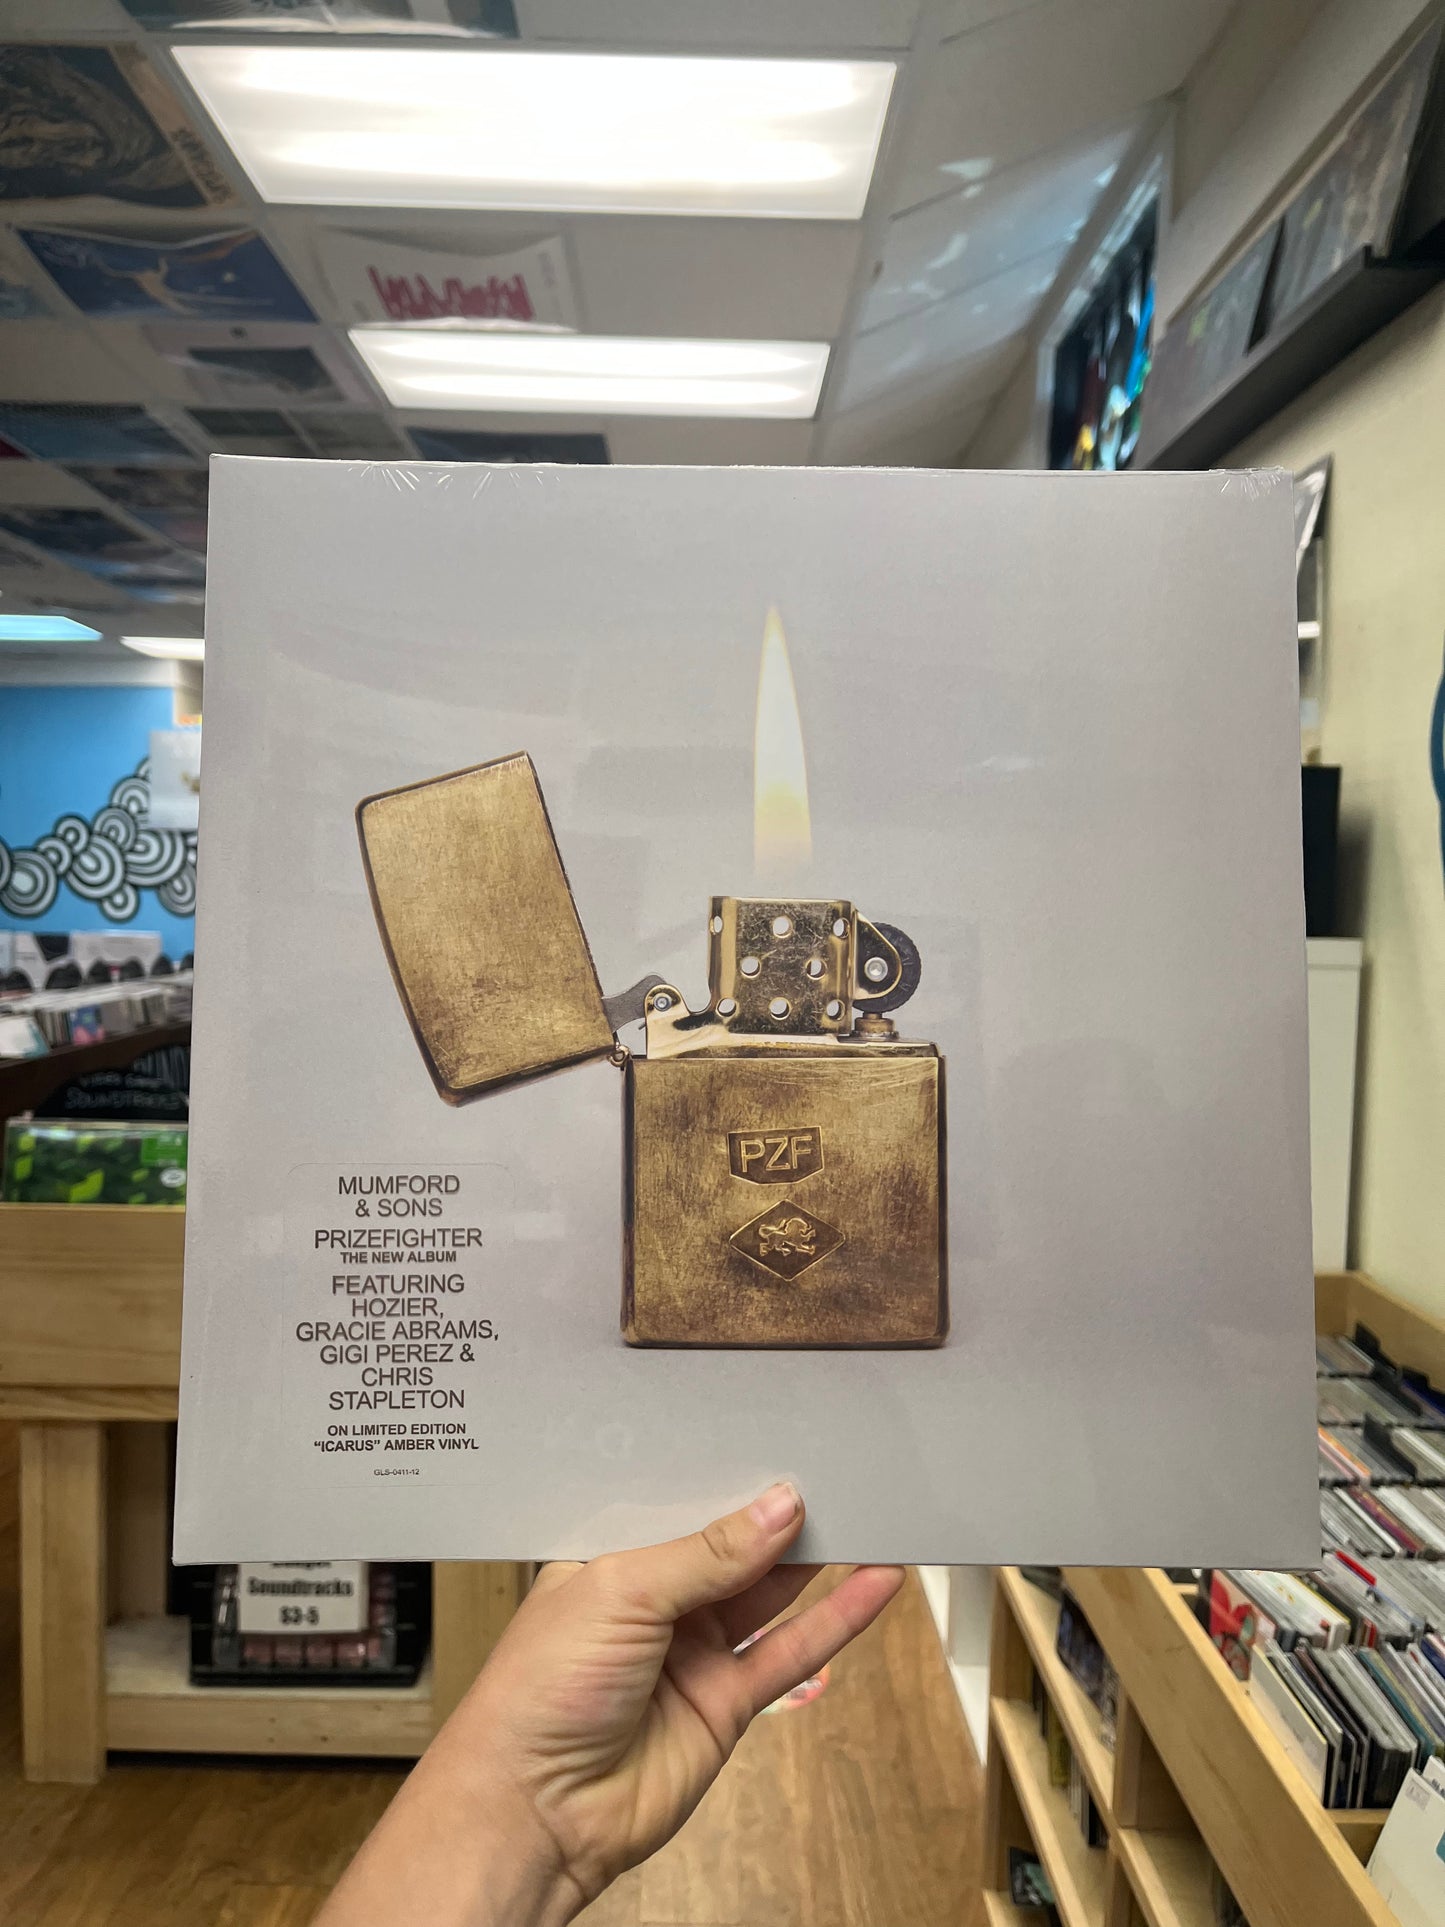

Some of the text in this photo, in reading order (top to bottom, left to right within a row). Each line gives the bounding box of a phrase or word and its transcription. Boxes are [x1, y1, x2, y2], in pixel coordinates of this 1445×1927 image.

[740, 1135, 813, 1173] PZF
[339, 1175, 459, 1194] MUMFORD
[356, 1198, 442, 1217] & SONS
[315, 1228, 482, 1249] PRIZEFIGHTER
[340, 1251, 456, 1264] THE NEW ALBUM
[333, 1274, 464, 1295] FEATURING
[352, 1298, 443, 1319] HOZIER,
[296, 1320, 498, 1342] GRACIE ABRAMS,
[320, 1343, 475, 1364] GIGI PEREZ &
[362, 1367, 433, 1386] CHRIS
[329, 1390, 464, 1410] STAPLETON
[328, 1424, 465, 1436] ON LIMITED EDITION
[314, 1439, 479, 1452] “ICARUS” AMBER VINYL
